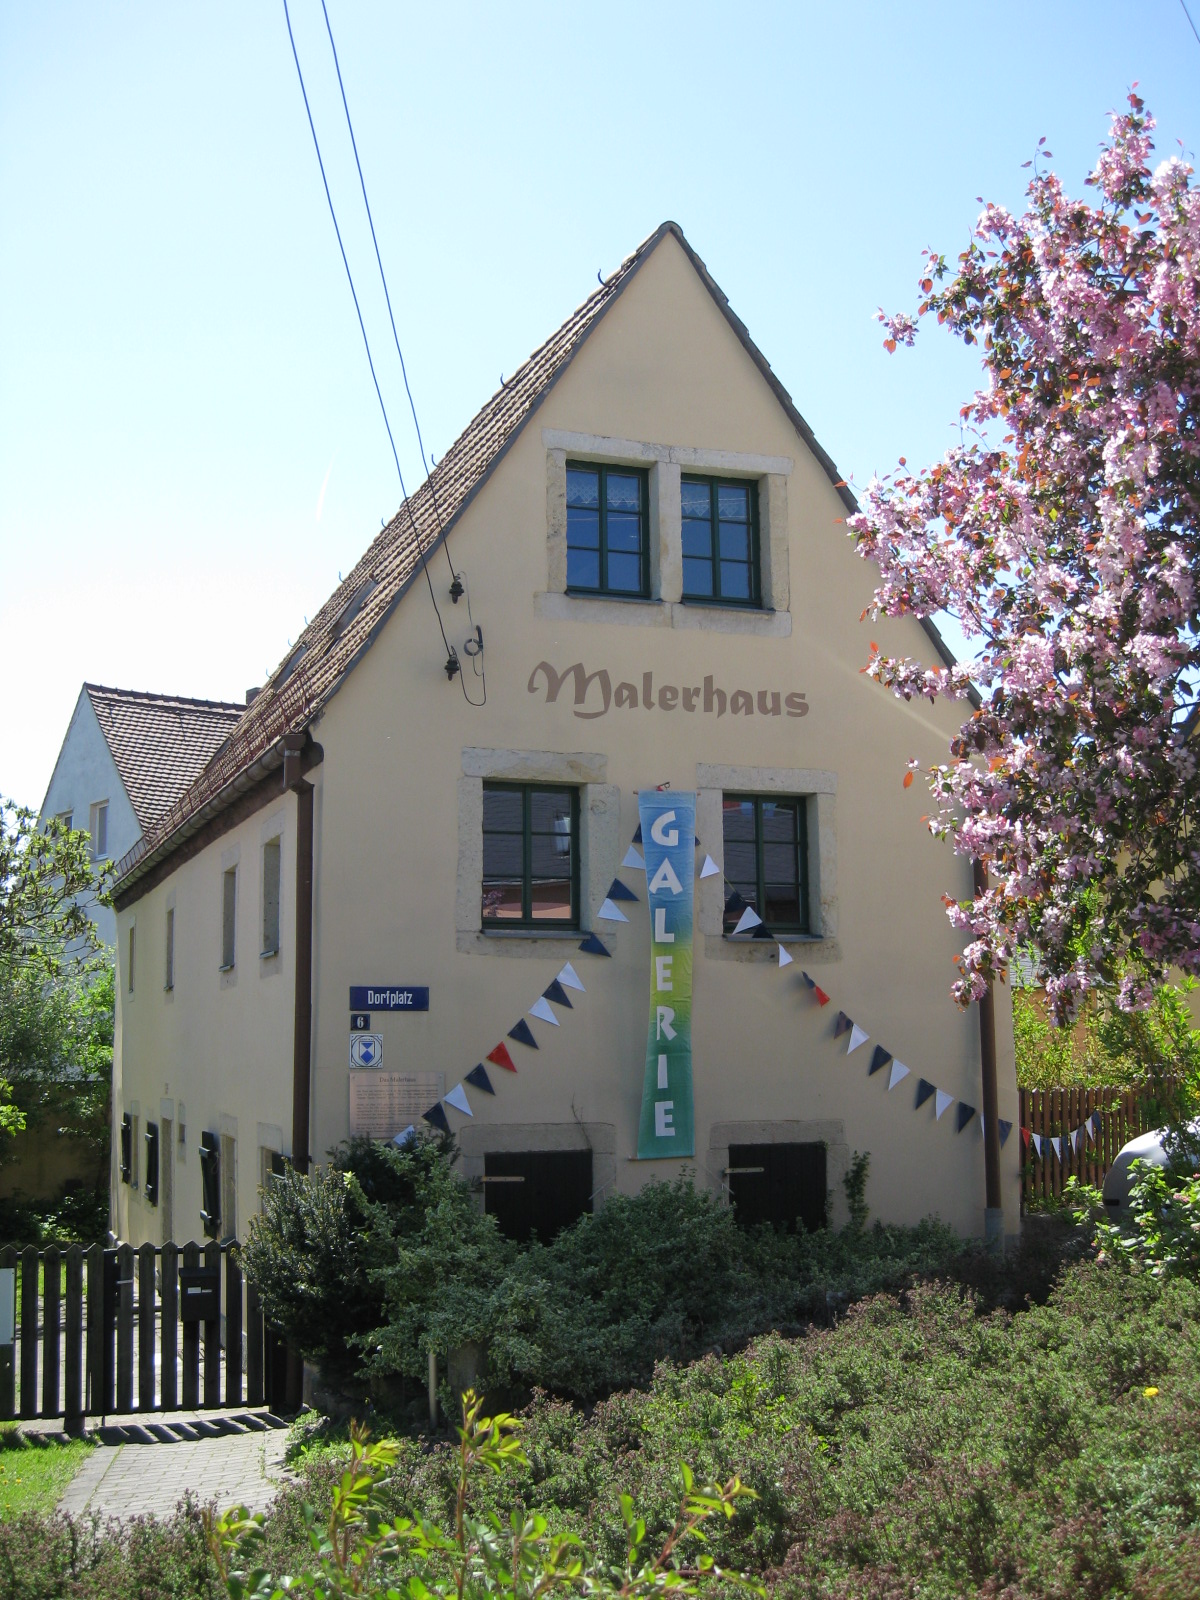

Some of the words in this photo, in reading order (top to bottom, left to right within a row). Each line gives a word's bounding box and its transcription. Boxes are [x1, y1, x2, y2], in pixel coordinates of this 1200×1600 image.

[527, 660, 810, 720] Malerhaus
[648, 810, 683, 1137] GALERIE
[367, 990, 413, 1007] Dorfplatz
[356, 1016, 364, 1029] 6
